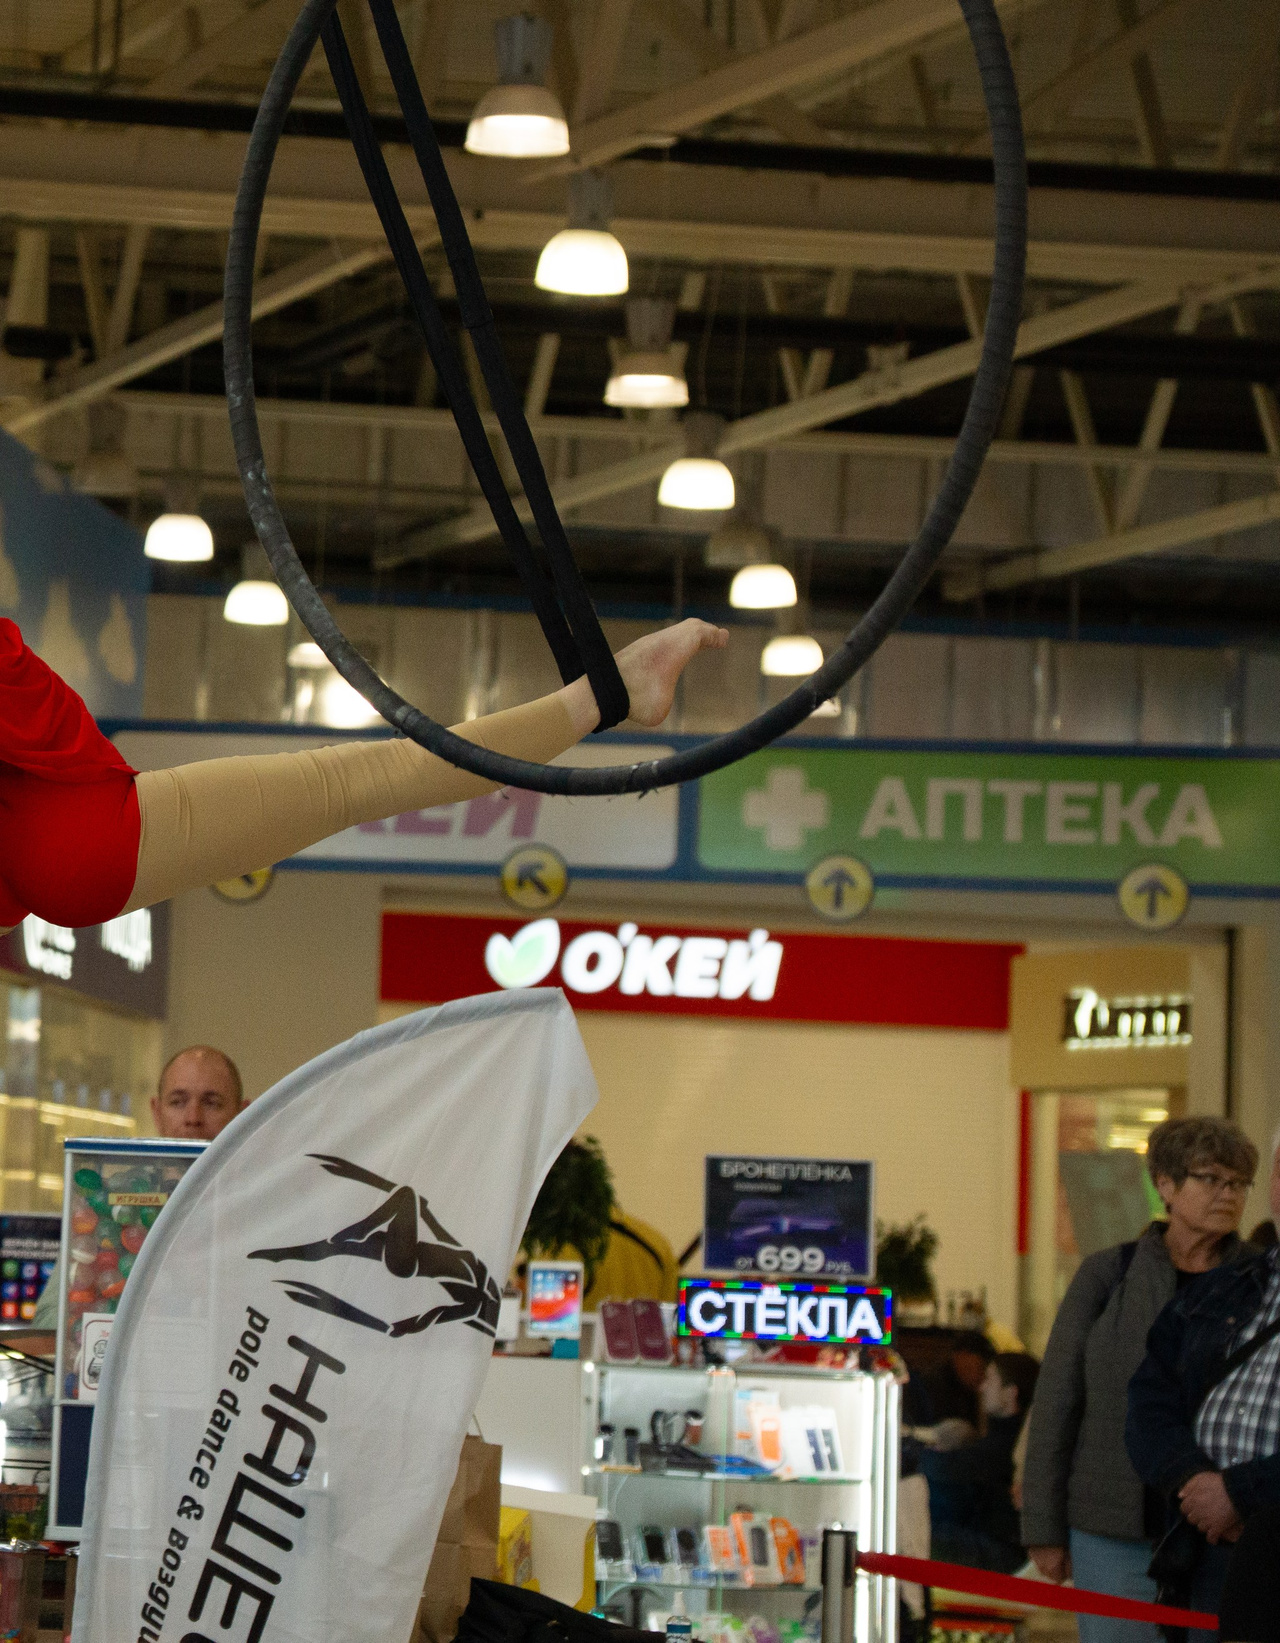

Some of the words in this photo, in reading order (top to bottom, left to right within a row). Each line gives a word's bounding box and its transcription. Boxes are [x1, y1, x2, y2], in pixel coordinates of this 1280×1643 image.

[859, 777, 1223, 848] АПТЕКА
[560, 922, 784, 1002] О'КЕЙ
[115, 1194, 161, 1205] ИГРУШКА
[735, 1256, 754, 1270] ОТ
[756, 1245, 825, 1273] 699
[228, 1305, 270, 1383] pole
[688, 1286, 884, 1340] СТЁКЛА
[189, 1388, 242, 1490] dance
[176, 1494, 205, 1521] &
[179, 1334, 347, 1643] НАШЕ
